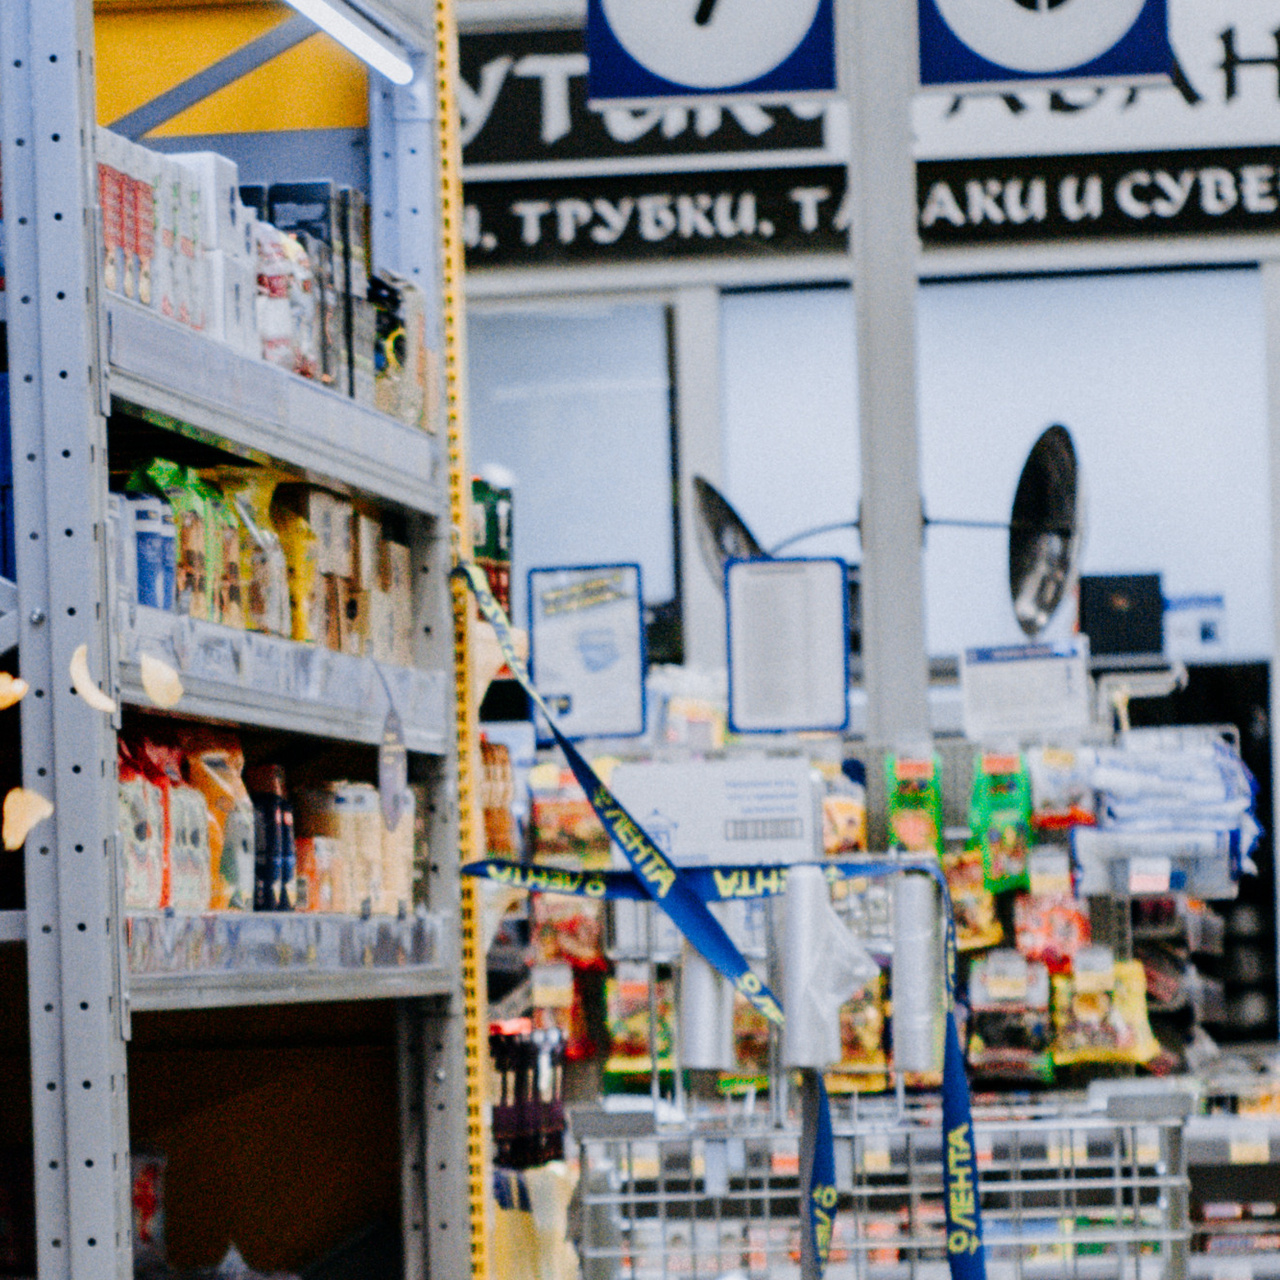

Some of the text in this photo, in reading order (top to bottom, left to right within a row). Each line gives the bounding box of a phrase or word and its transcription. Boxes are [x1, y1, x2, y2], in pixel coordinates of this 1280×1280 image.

[512, 193, 775, 246] ТРУБКИ.
[1058, 173, 1103, 222] И
[605, 808, 677, 898] ЛЕНТА
[947, 1121, 977, 1230] ЛЕНТА
